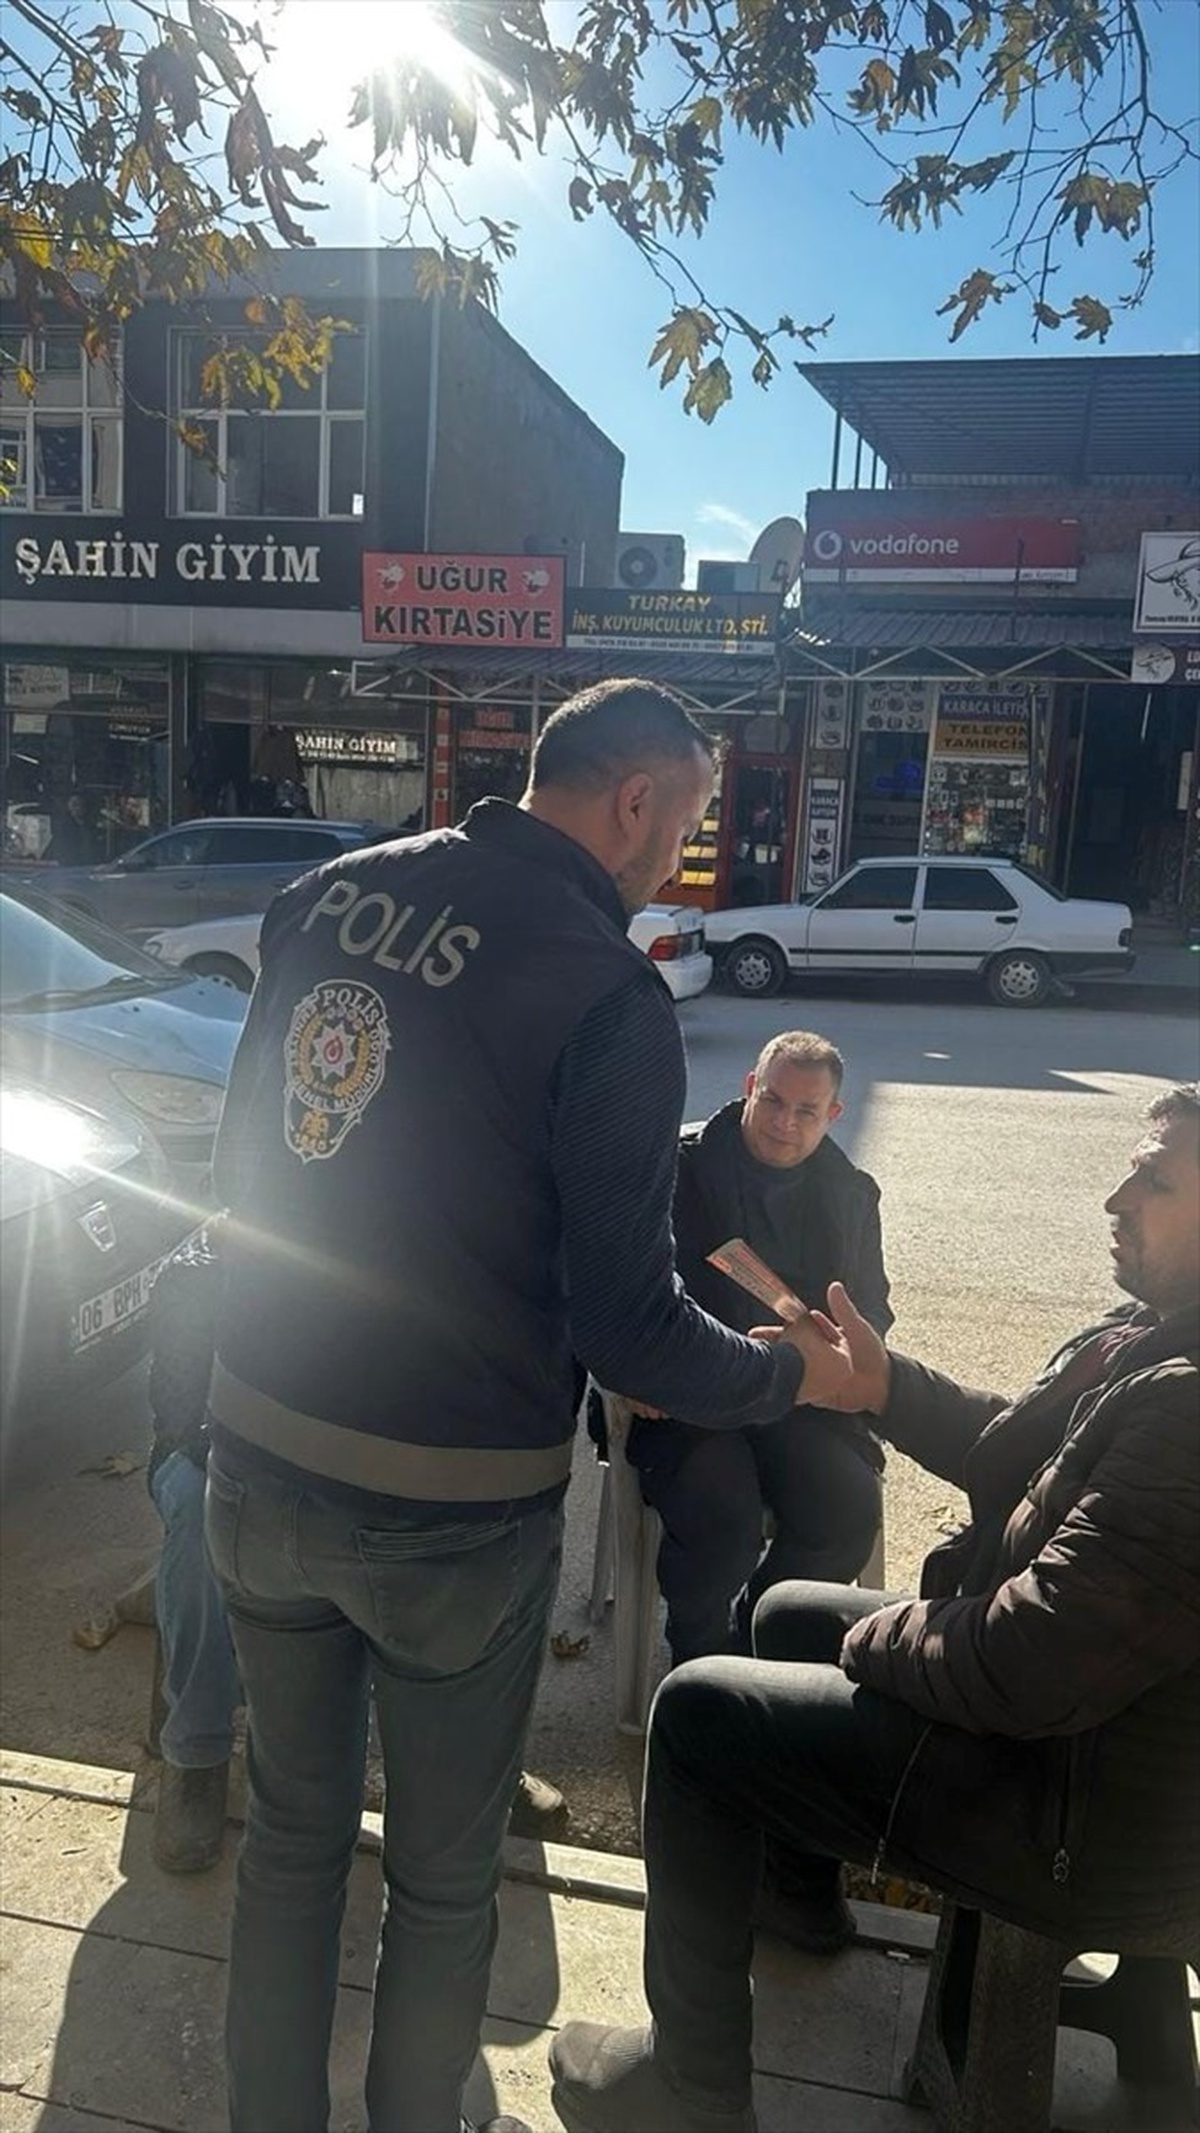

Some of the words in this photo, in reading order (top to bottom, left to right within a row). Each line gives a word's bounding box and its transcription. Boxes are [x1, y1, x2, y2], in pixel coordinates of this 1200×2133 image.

[15, 531, 160, 585] ŞAHİN
[176, 534, 321, 583] GİYİM
[850, 533, 959, 555] vodafone
[417, 560, 508, 593] UĞUR
[603, 614, 706, 634] KUYUMCULUK
[302, 879, 481, 987] POLİS
[322, 988, 380, 1025] POLİS
[82, 1298, 103, 1337] 06
